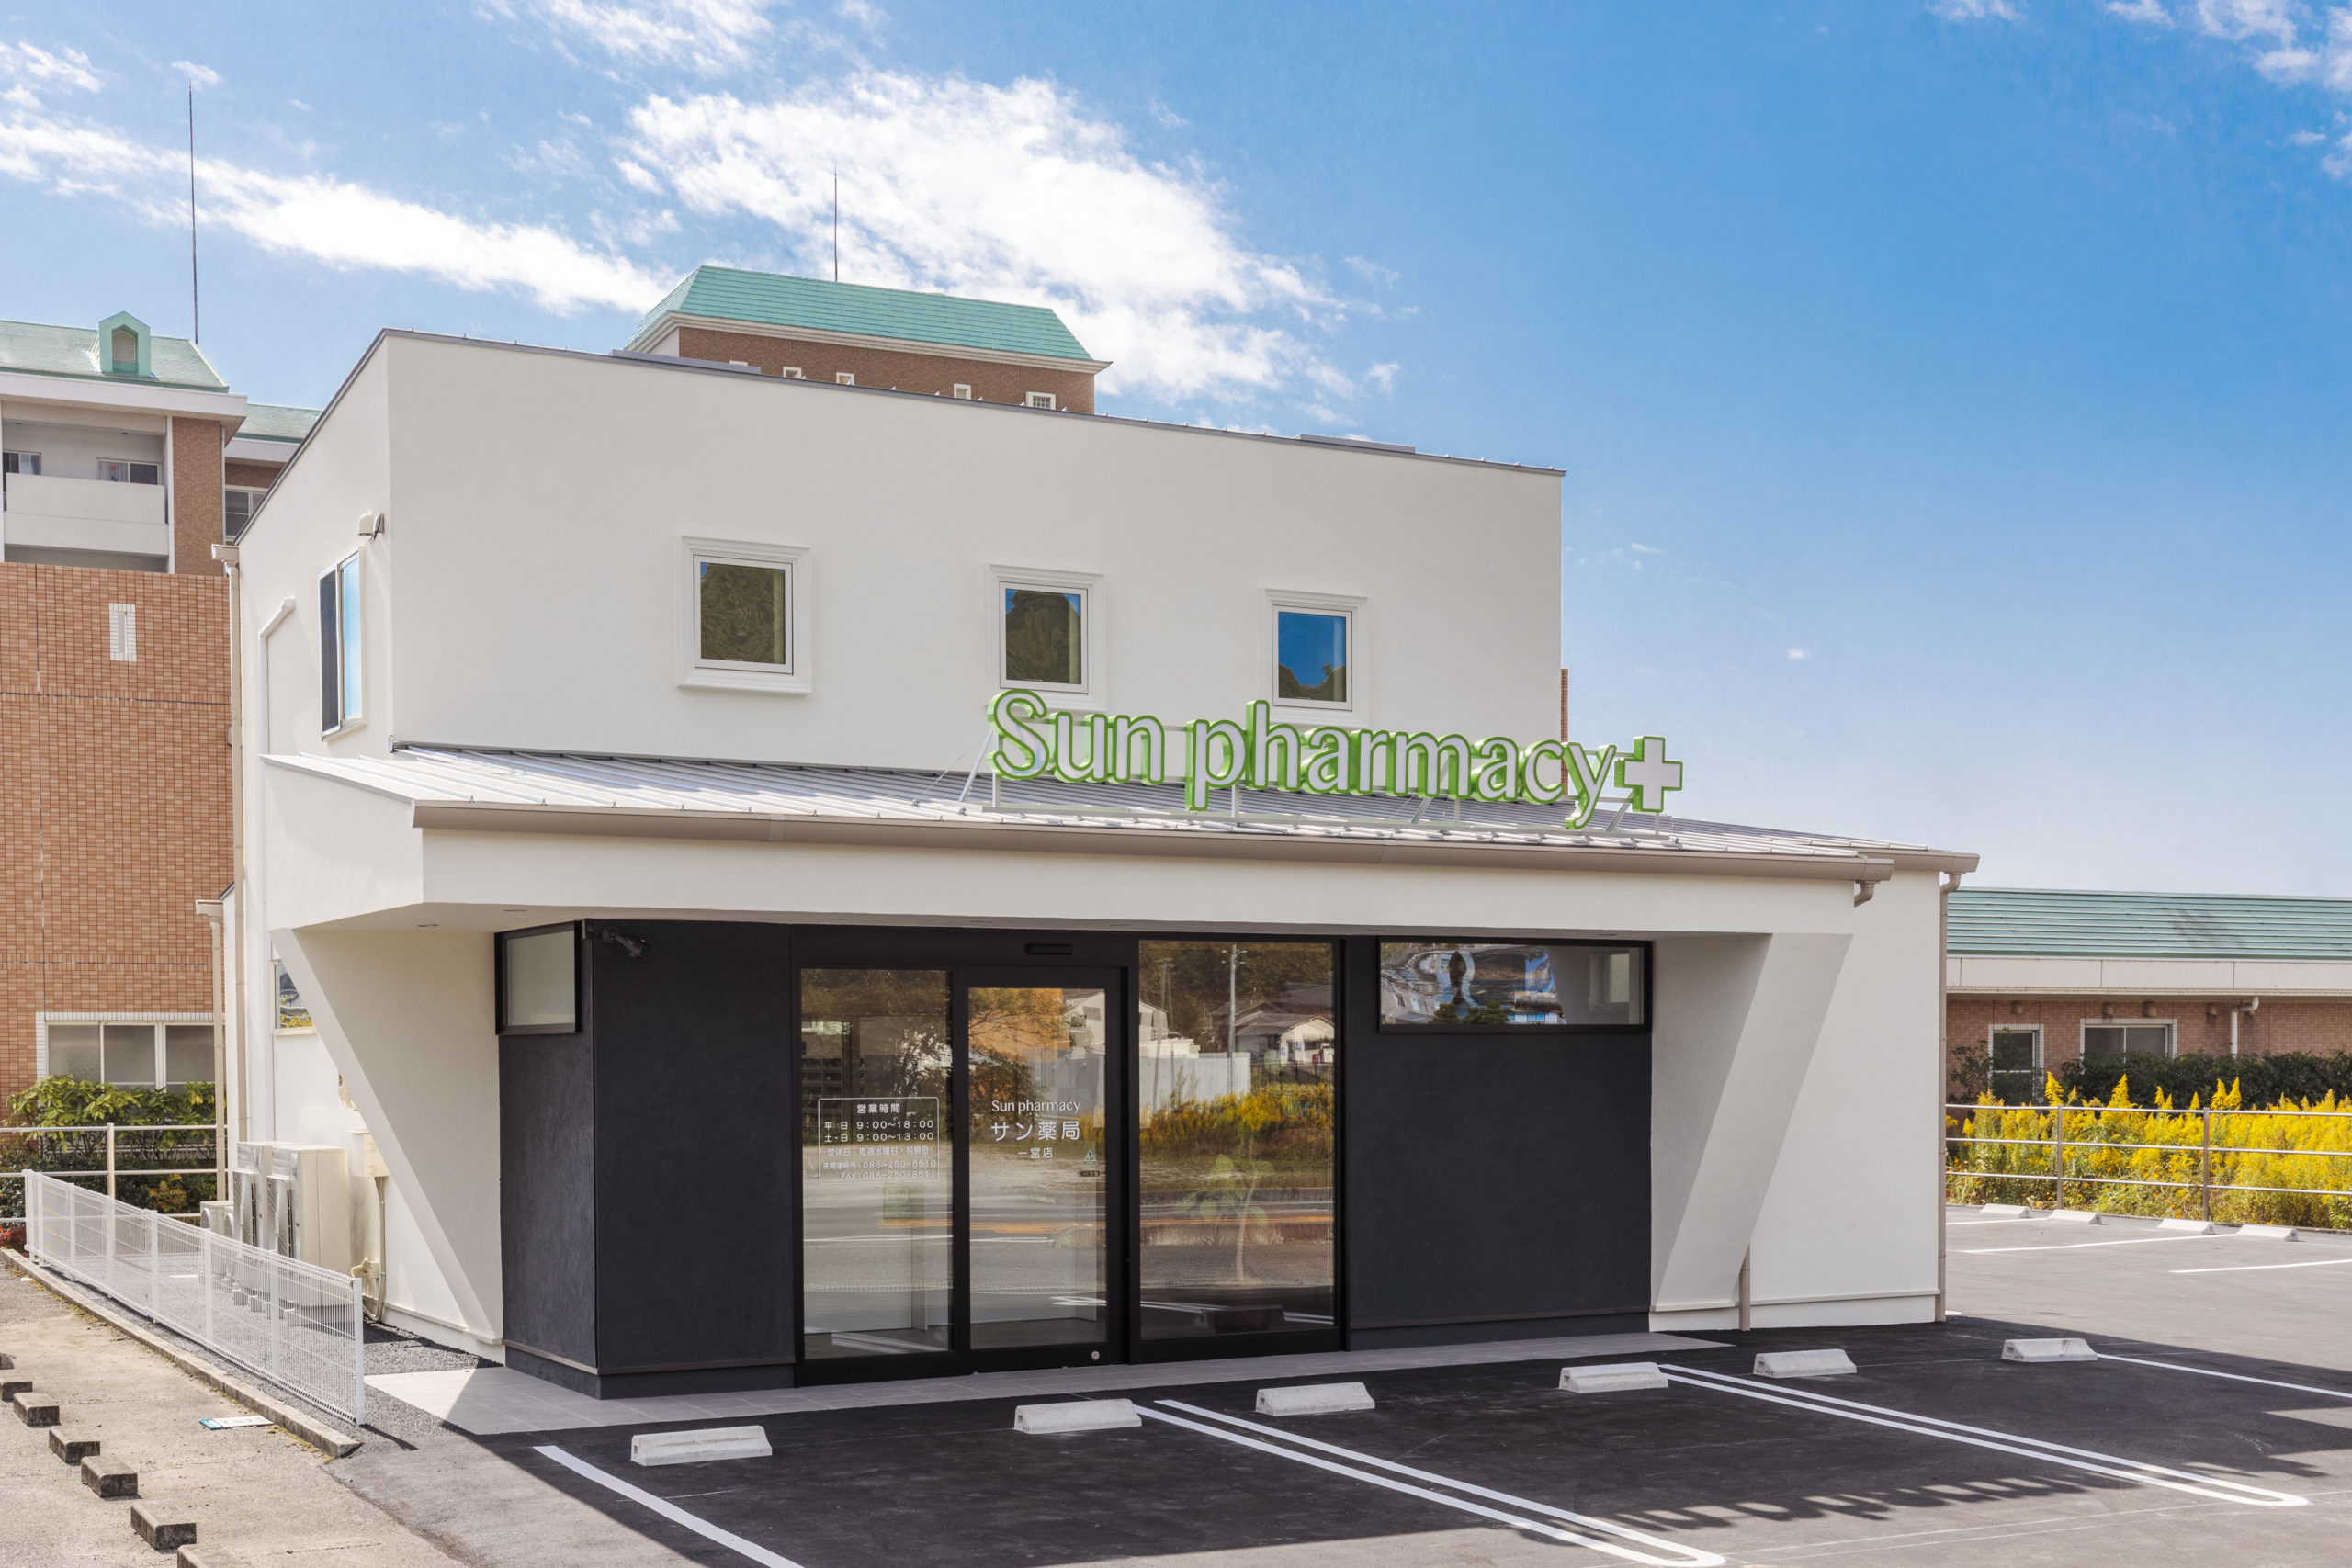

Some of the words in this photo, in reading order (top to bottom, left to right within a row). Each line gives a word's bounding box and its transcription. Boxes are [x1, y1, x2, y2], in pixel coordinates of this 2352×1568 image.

[987, 689, 1165, 784] Sun
[1185, 699, 1617, 829] pharmacy
[856, 1103, 900, 1114] 営業時間
[991, 1100, 1015, 1112] Sun
[1018, 1099, 1081, 1115] pharmacy
[990, 1121, 1080, 1142] サン薬局
[827, 1147, 851, 1156] 定休日
[1017, 1146, 1053, 1158] 一宮店
